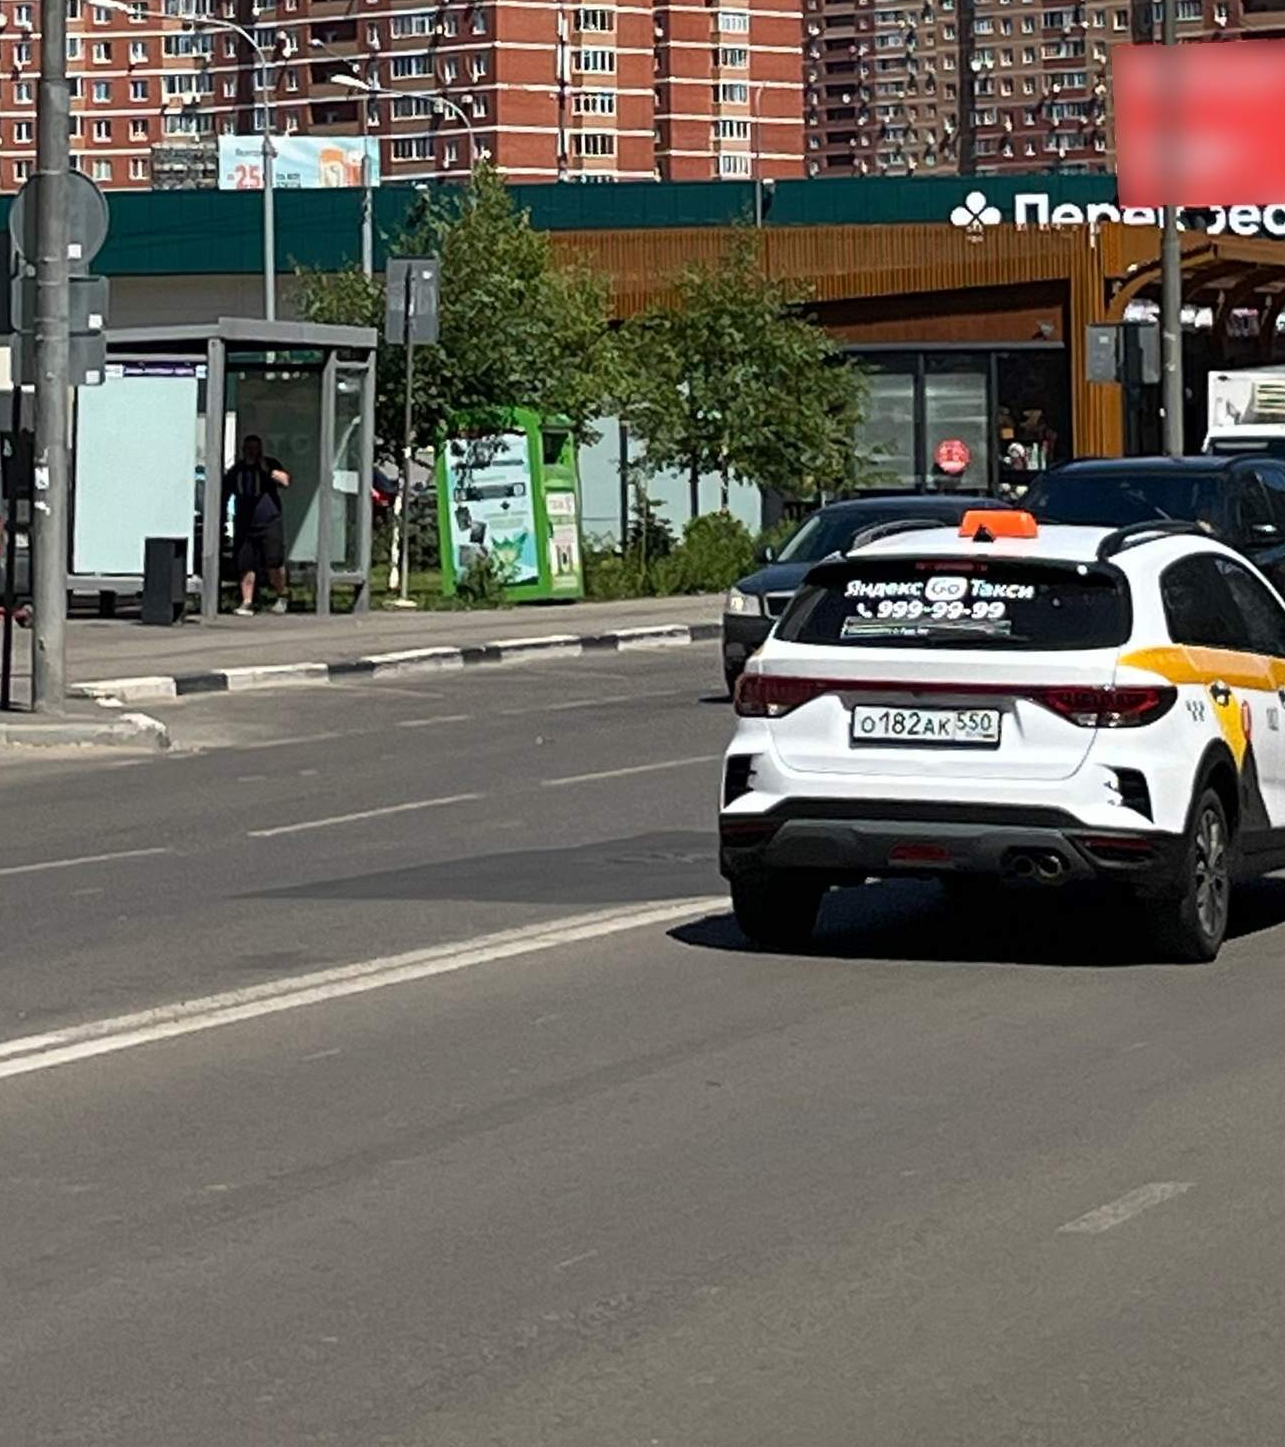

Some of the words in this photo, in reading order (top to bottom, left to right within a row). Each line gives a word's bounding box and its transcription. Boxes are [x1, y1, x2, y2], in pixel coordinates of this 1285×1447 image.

[844, 579, 924, 598] Яндекс
[970, 579, 1035, 599] Такси
[876, 600, 1006, 619] 999-99-99
[955, 712, 992, 732] 550
